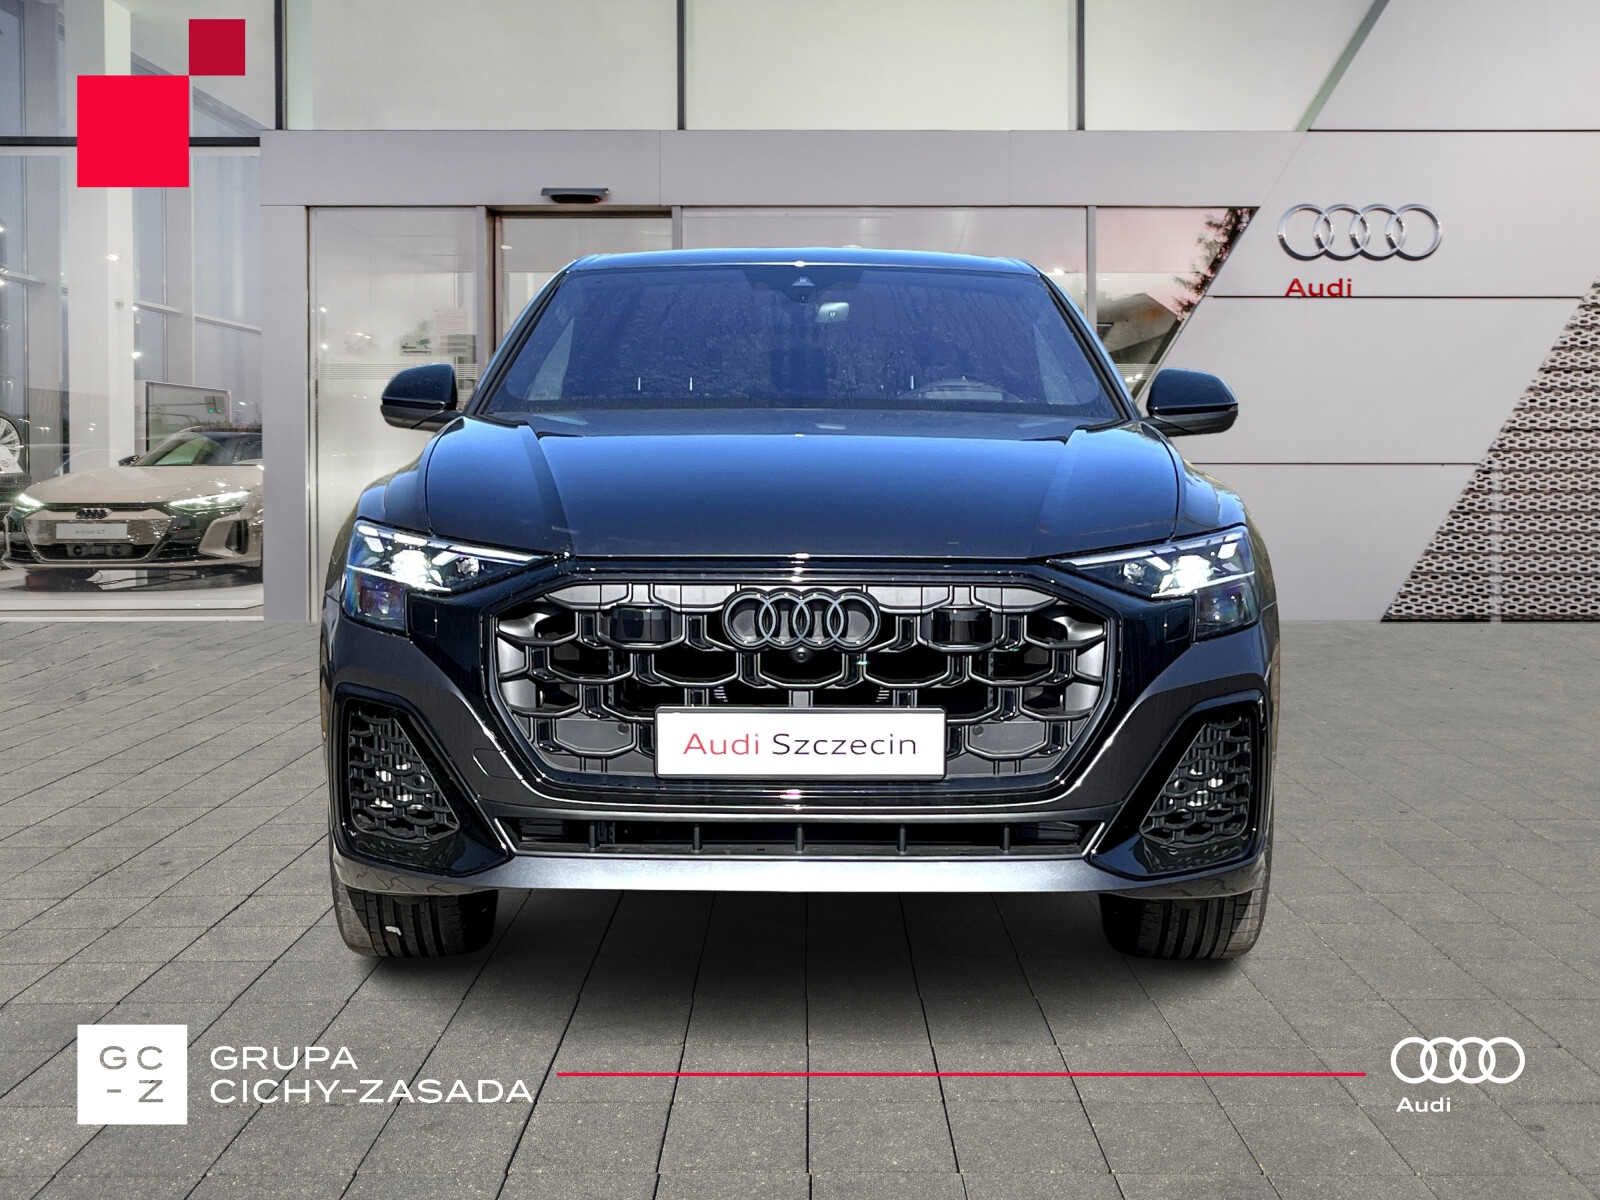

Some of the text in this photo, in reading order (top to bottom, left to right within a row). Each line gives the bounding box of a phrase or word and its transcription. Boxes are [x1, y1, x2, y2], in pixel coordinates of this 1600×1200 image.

[1285, 278, 1352, 297] Audi
[684, 733, 916, 756] Audi Szczecin
